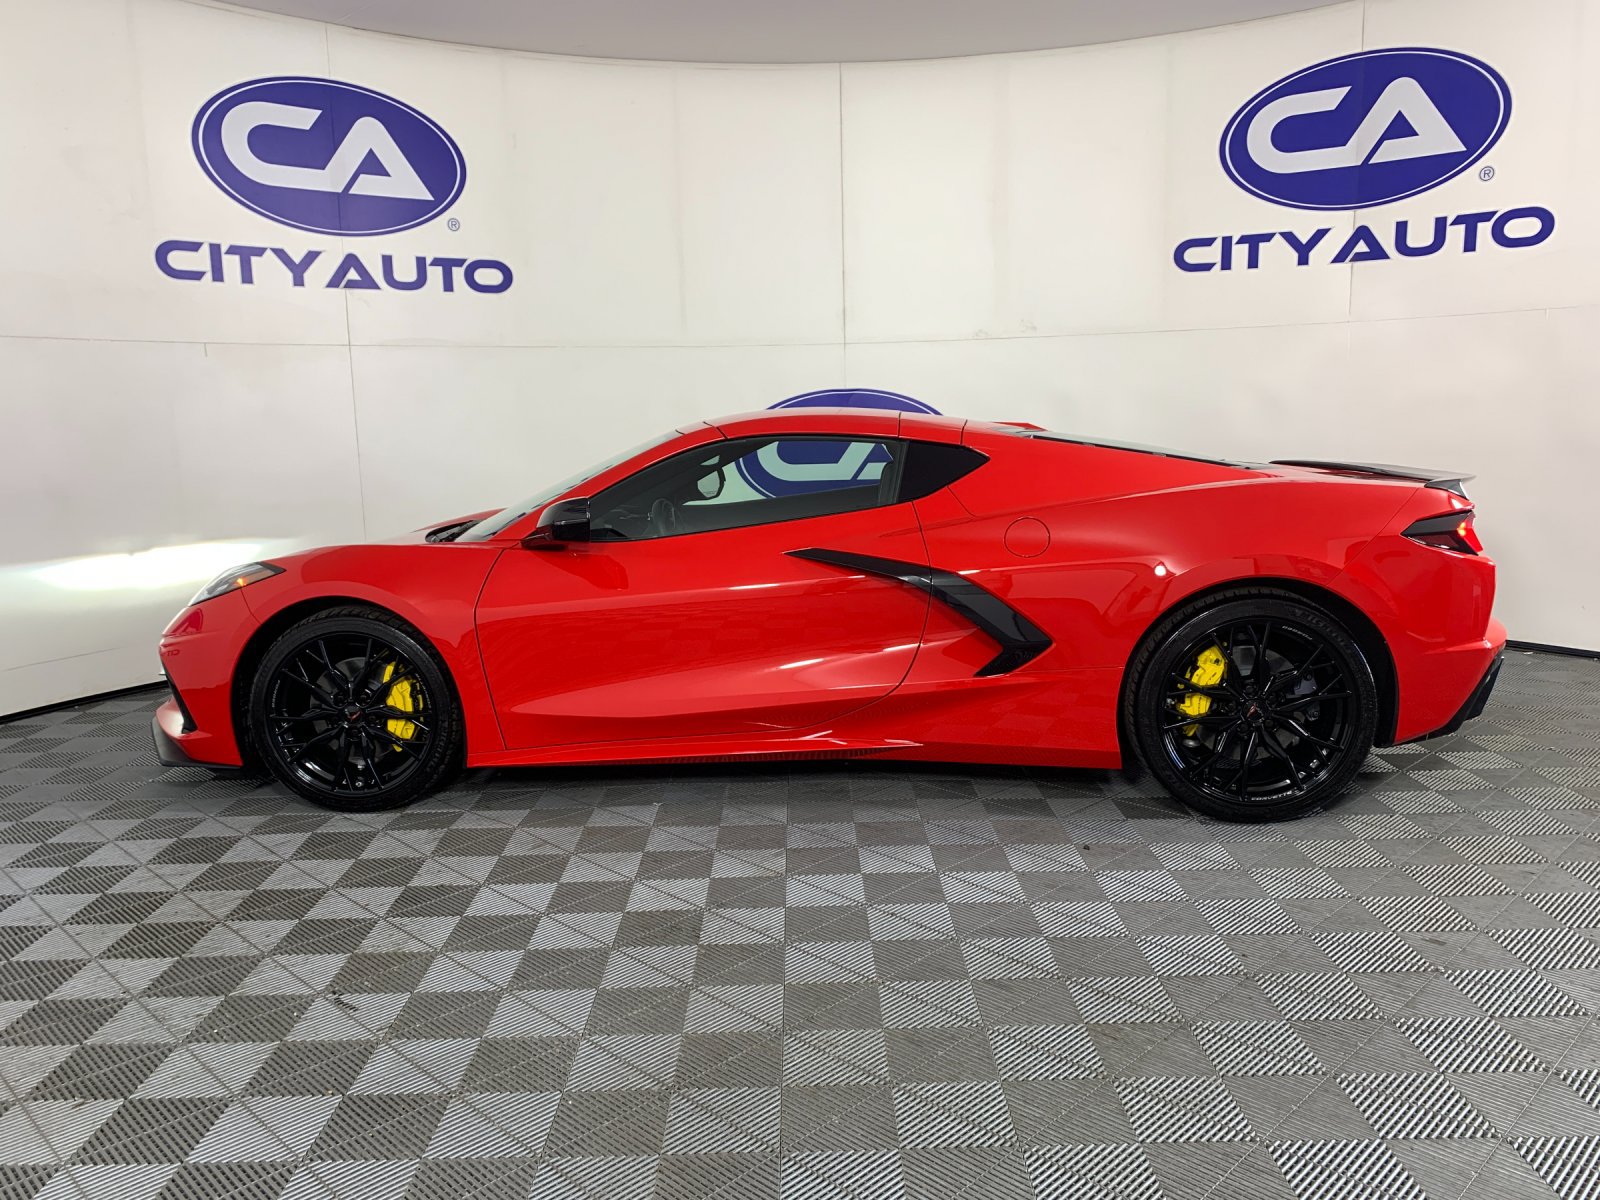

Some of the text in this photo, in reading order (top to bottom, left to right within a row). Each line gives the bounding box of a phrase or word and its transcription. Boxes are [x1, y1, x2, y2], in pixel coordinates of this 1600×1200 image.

[221, 101, 435, 201] CA
[1246, 76, 1468, 174] CA
[154, 239, 514, 294] CITY AUTO
[1173, 206, 1556, 273] CITY AUTO
